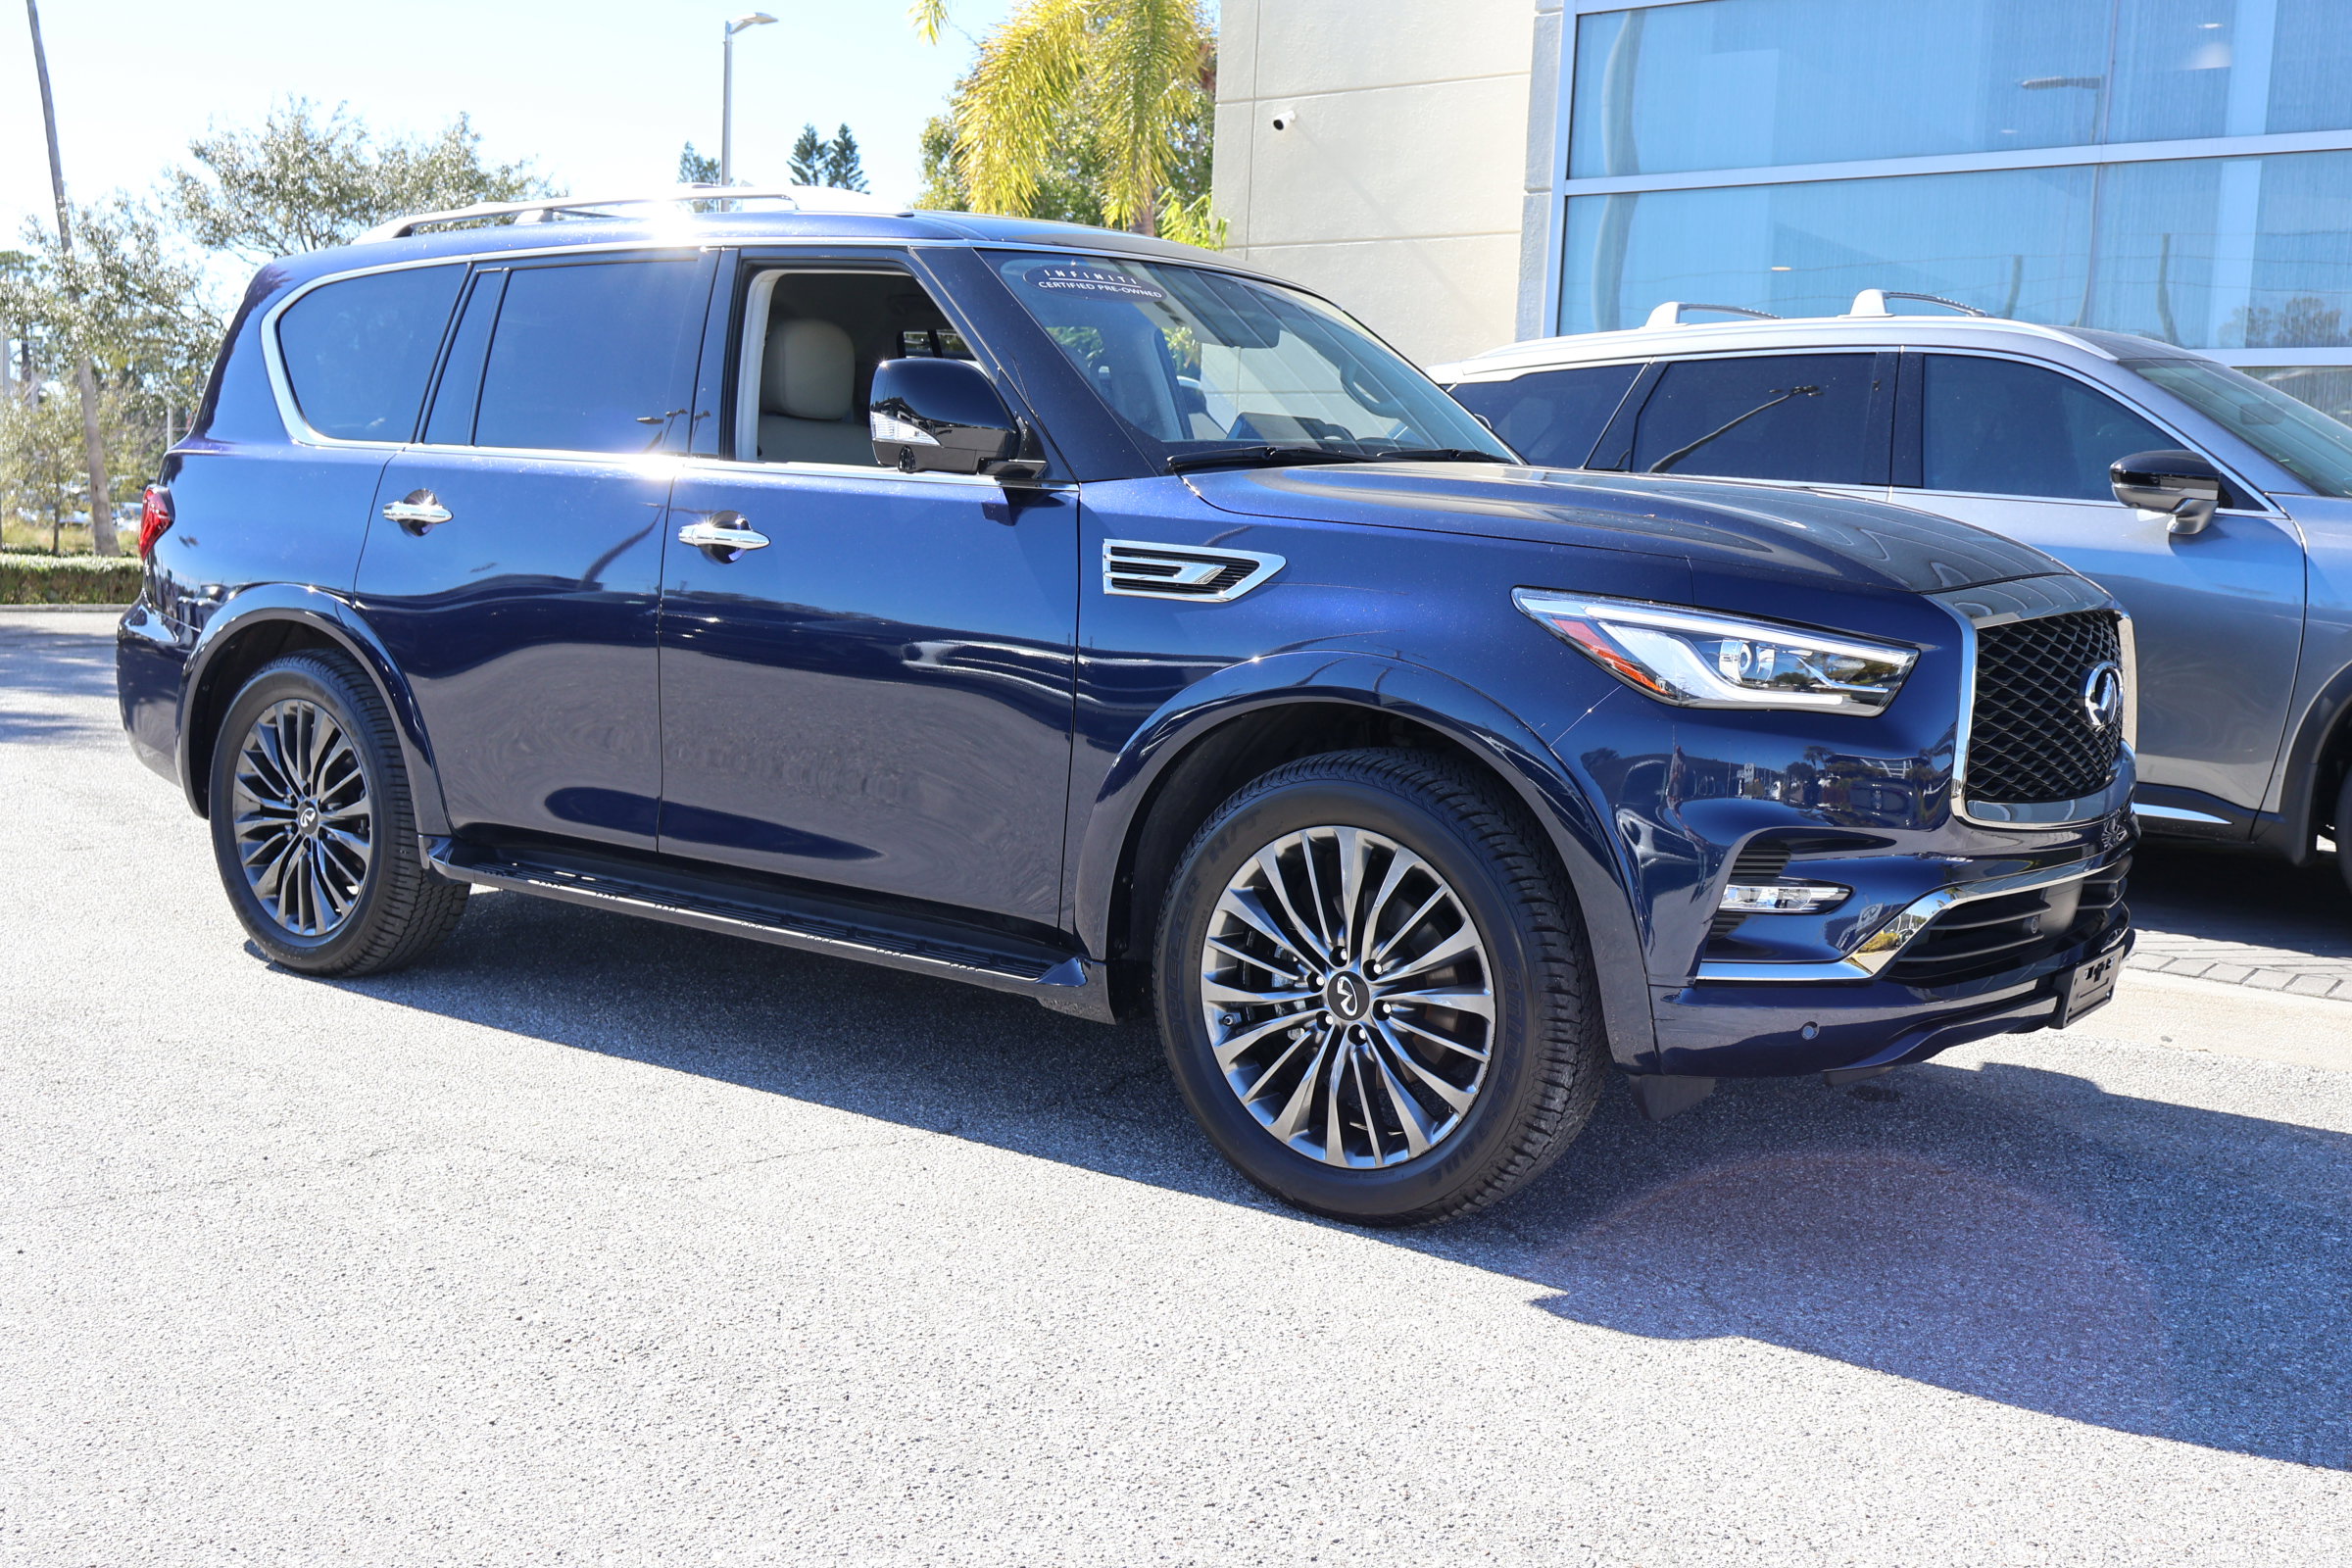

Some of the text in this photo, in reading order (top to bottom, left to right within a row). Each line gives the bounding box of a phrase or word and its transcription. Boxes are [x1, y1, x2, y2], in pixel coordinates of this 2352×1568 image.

[1044, 269, 1137, 284] INFINITI
[1038, 281, 1162, 298] CERTIFIED PRE-OWNED
